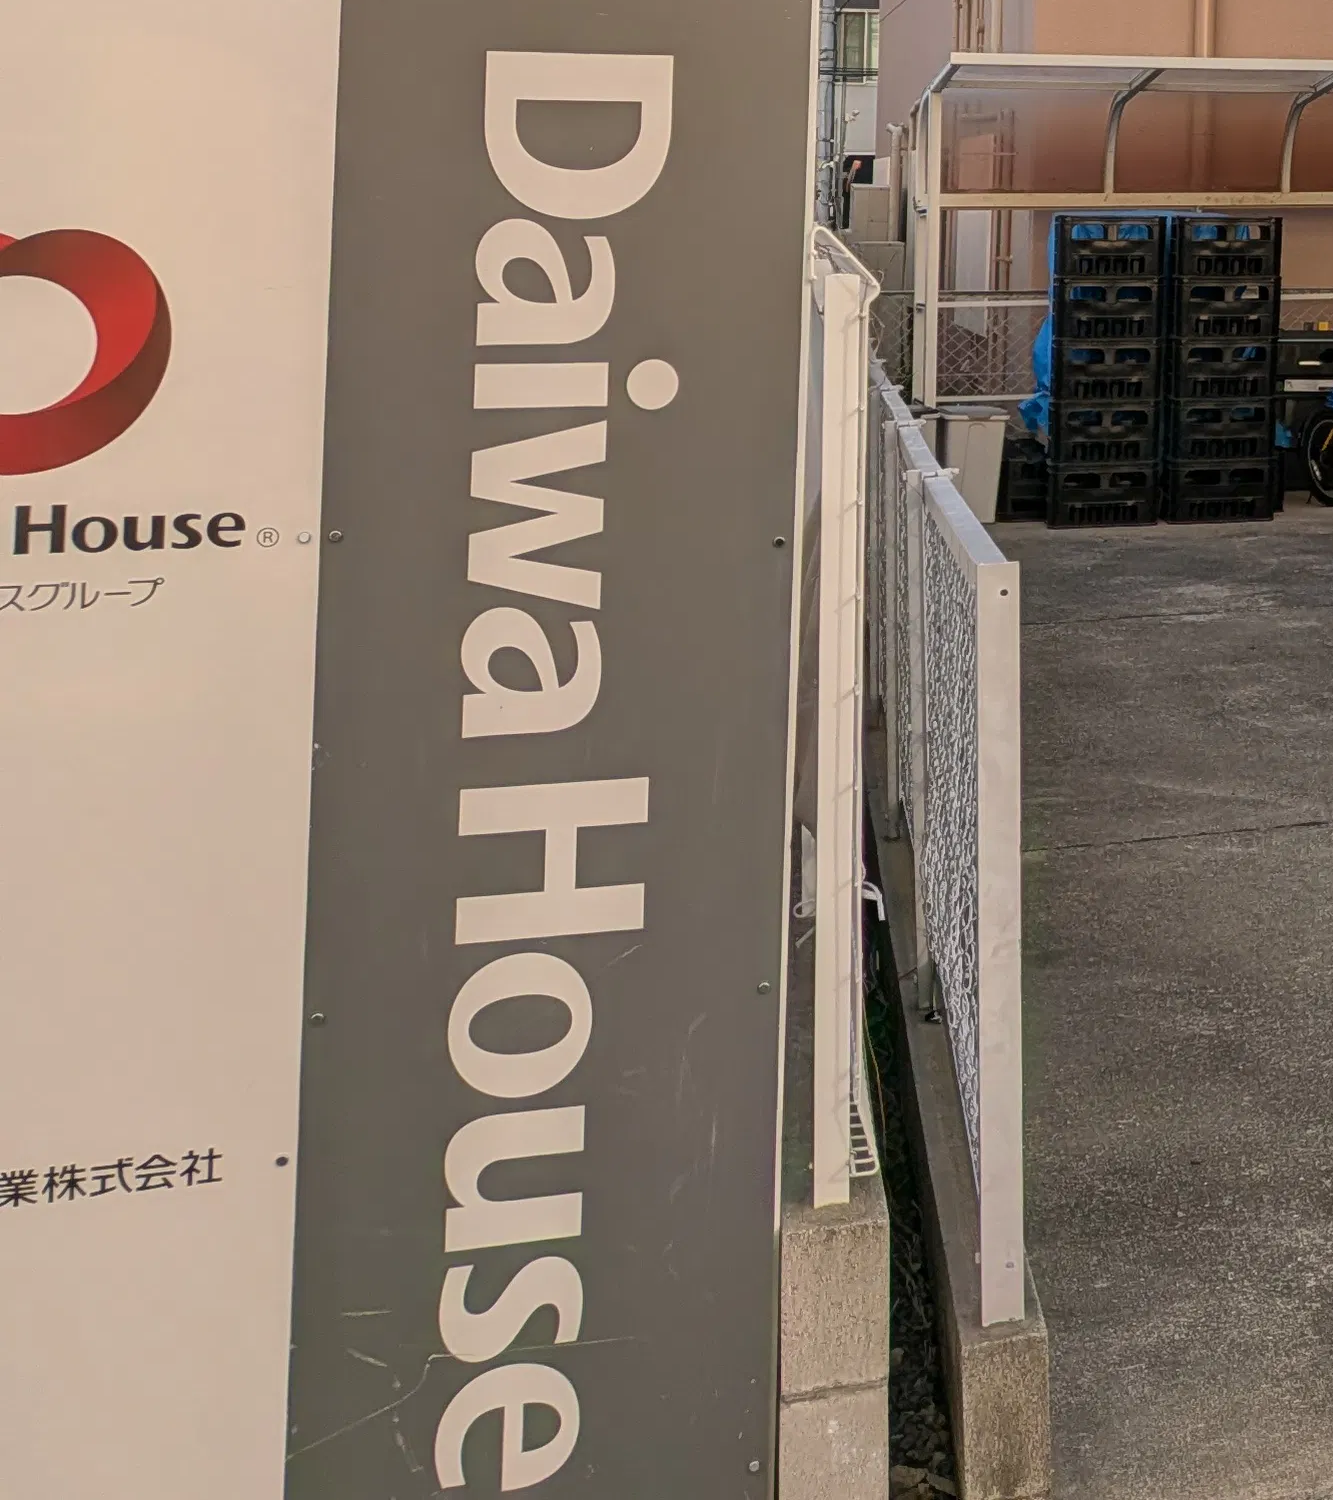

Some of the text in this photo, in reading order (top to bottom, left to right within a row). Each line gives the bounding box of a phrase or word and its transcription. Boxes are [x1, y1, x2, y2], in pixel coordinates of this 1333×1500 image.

[13, 504, 246, 555] House
[0, 577, 165, 611] スグループ
[433, 50, 680, 1492] Daiwa House
[0, 1148, 224, 1208] 業株式会社
